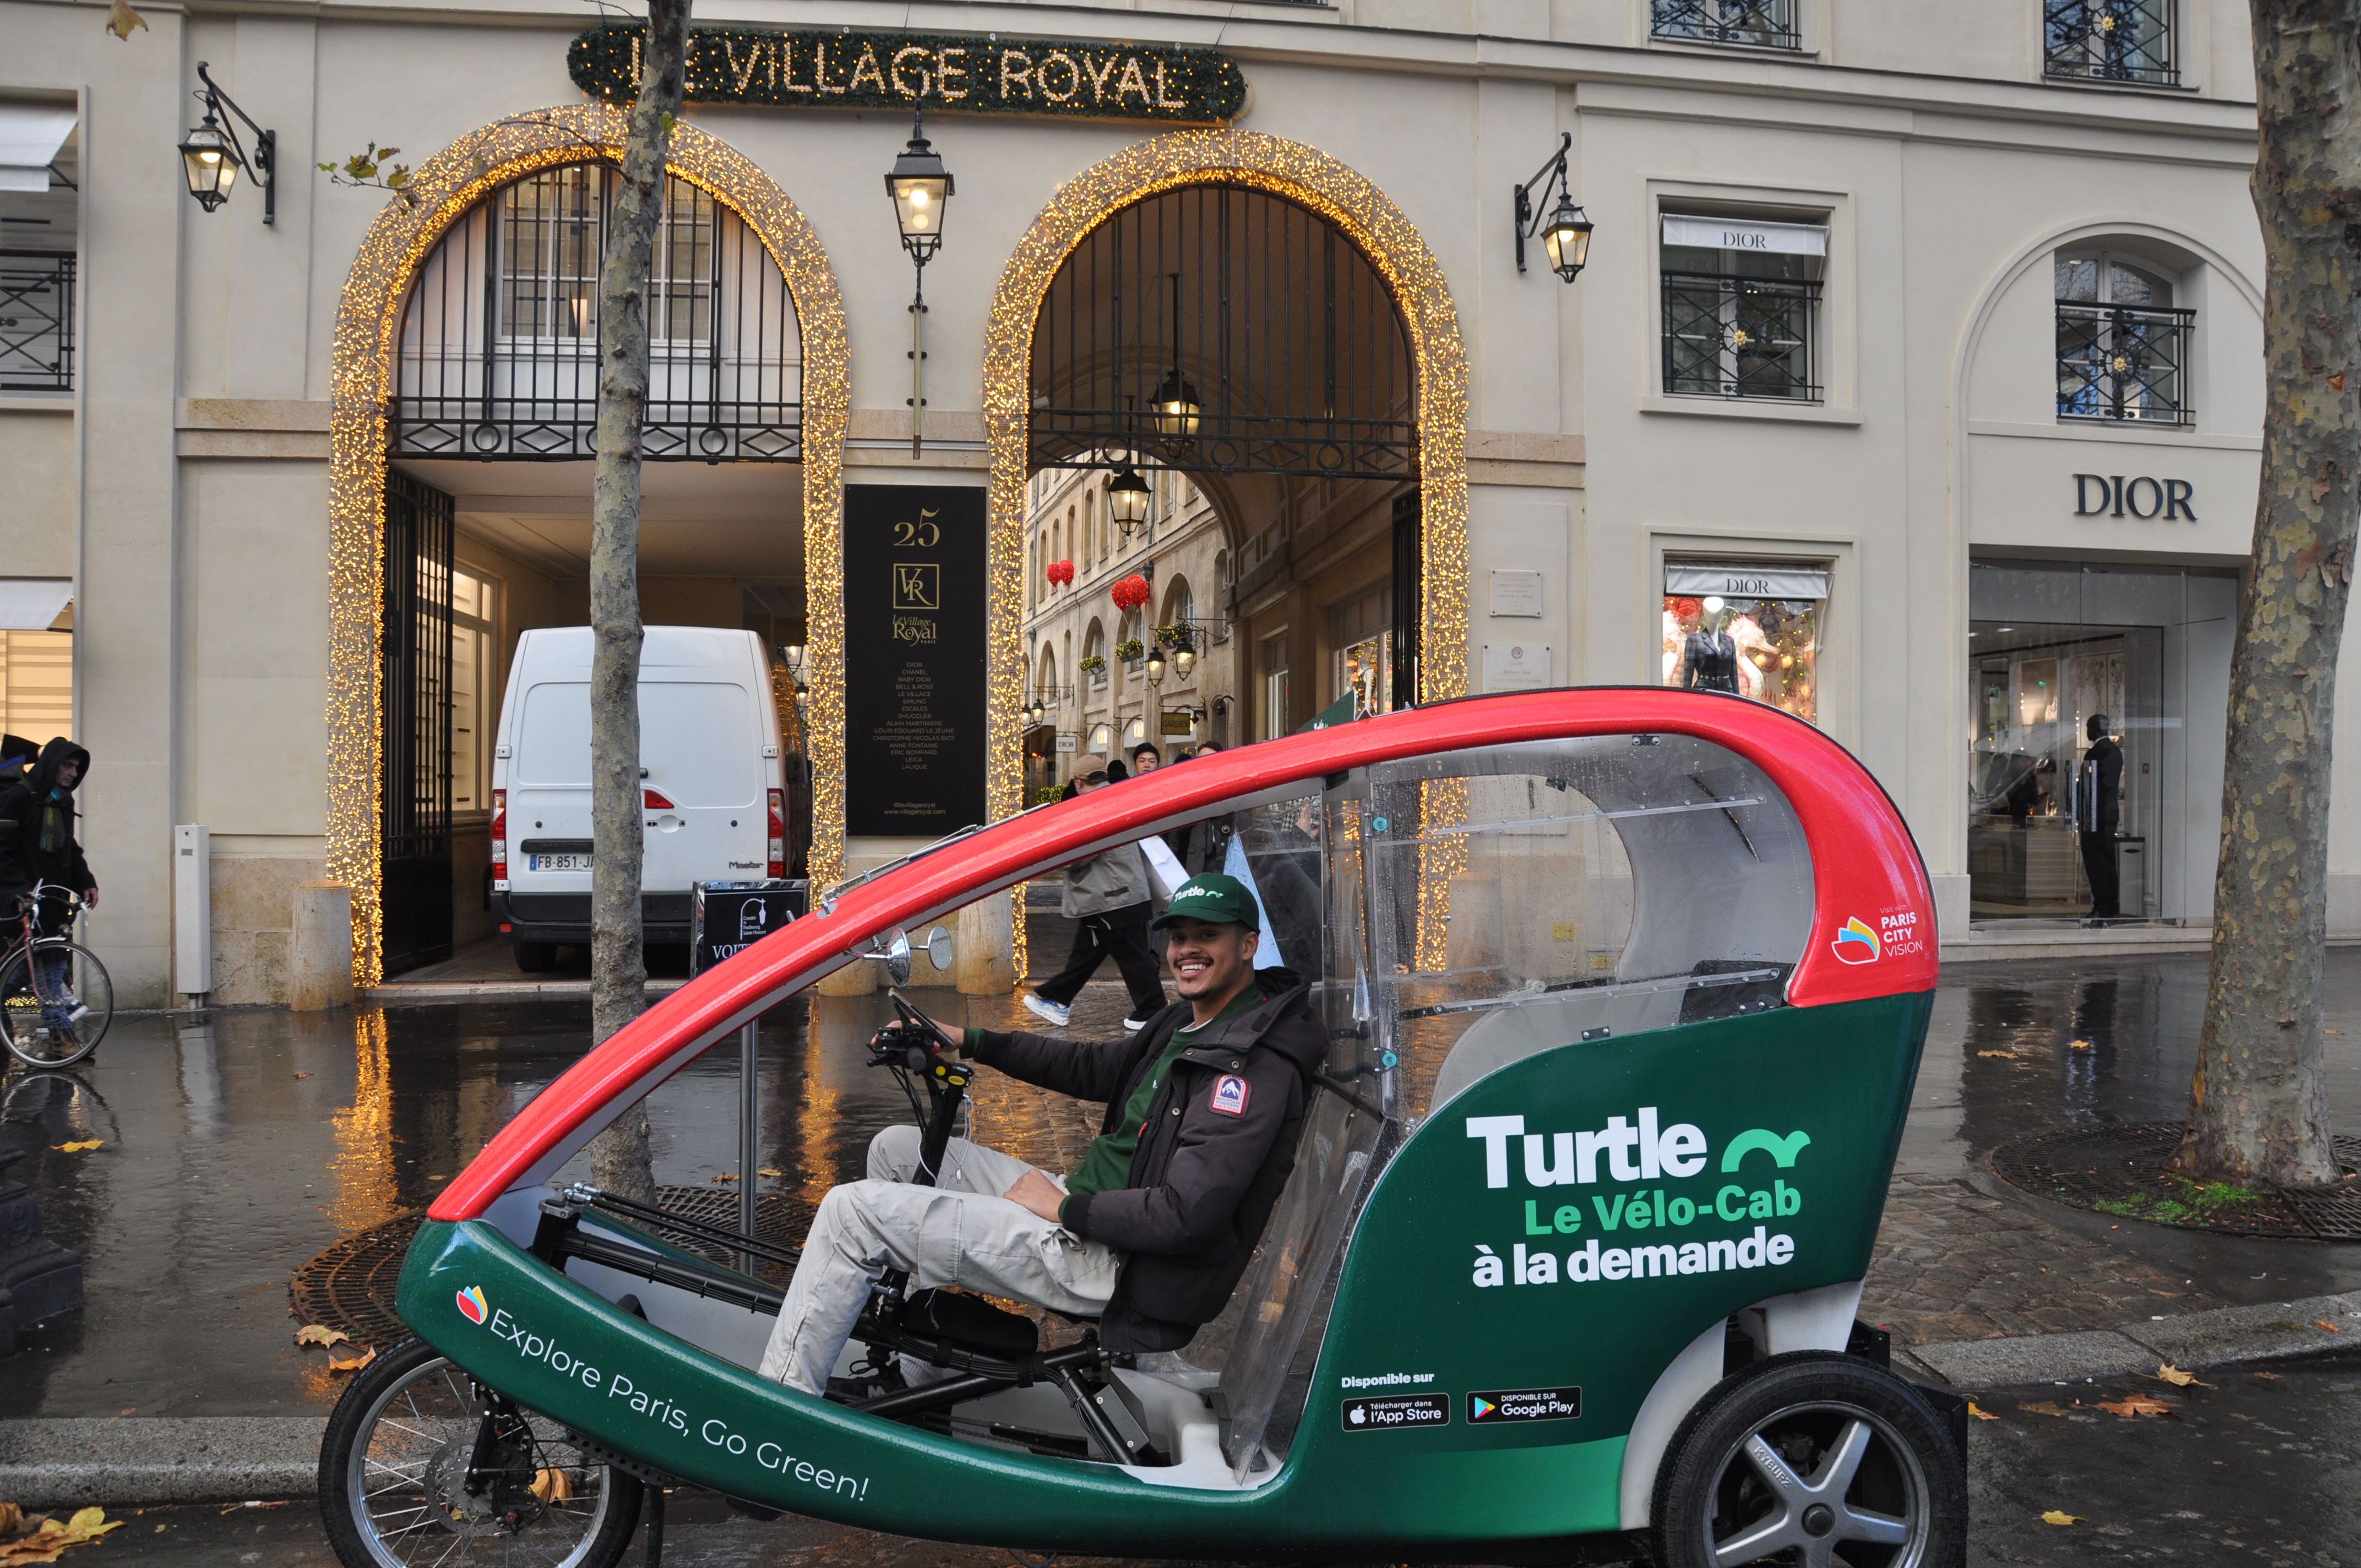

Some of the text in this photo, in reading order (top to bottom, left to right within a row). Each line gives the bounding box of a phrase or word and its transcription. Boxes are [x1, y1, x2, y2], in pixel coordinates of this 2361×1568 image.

[725, 40, 967, 97] VILLAGE
[1001, 51, 1185, 108] ROYAL
[1723, 232, 1766, 249] DIOR
[2072, 473, 2198, 521] DIOR
[894, 508, 940, 546] 25
[1726, 579, 1769, 594] DIOR
[893, 615, 931, 628] Le Village
[893, 623, 937, 646] Royal
[728, 861, 764, 869] Master
[1174, 886, 1205, 902] Turtle
[1881, 912, 1917, 929] PARIS
[1883, 927, 1912, 943] CITY
[1885, 940, 1923, 957] VISION
[1216, 1097, 1241, 1105] MOUNTAIN
[1466, 1106, 1707, 1189] Turtle
[1525, 1179, 1801, 1235] Le Vélo-Cab
[1472, 1226, 1795, 1288] à la demande
[1342, 1373, 1434, 1389] Disponible sur
[489, 1308, 870, 1501] Explore Paris, Go Green!
[1370, 1400, 1412, 1410] Télécharger
[1501, 1393, 1541, 1402] DISPONIBLE
[1407, 1408, 1442, 1421] Store
[1501, 1401, 1574, 1418] Google Play
[1753, 1445, 1793, 1489] KYBURZ
